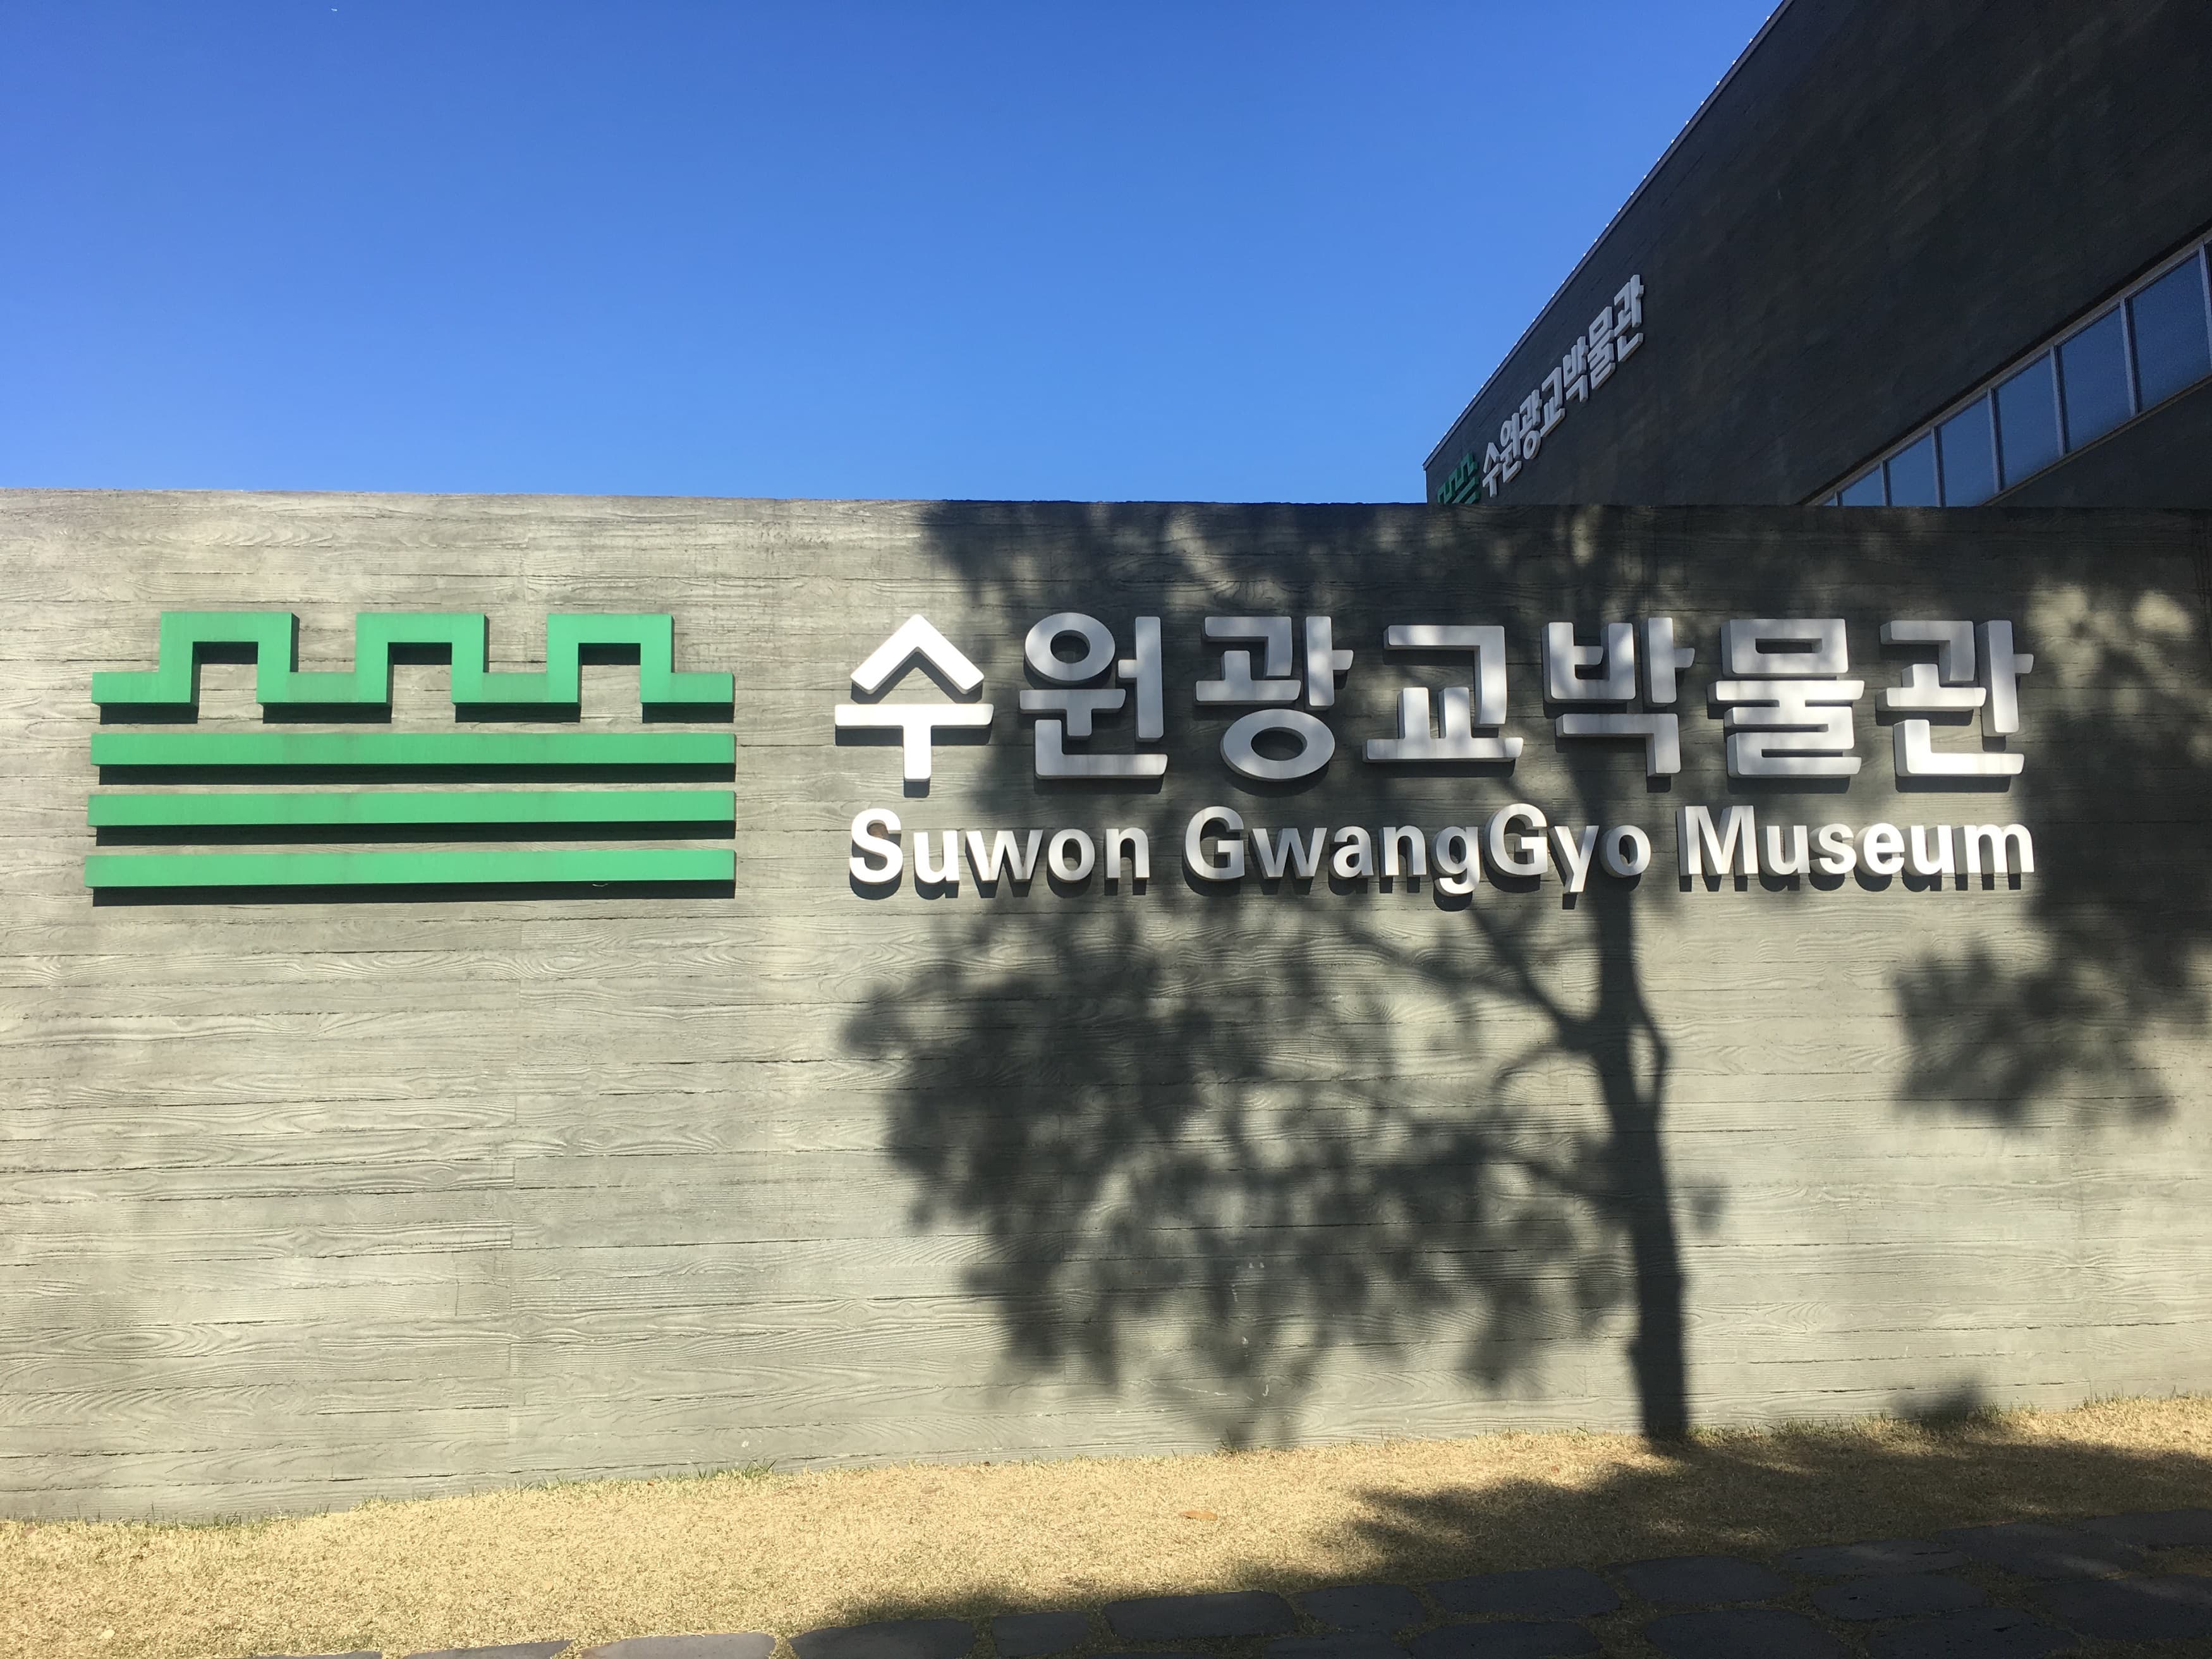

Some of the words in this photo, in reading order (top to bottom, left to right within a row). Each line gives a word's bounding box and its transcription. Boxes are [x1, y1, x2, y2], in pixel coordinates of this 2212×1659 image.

[1481, 274, 1644, 498] 수원광교박물관
[834, 612, 2034, 783] 수원광교박물관
[848, 807, 1151, 884] Suwon
[1183, 803, 1651, 896] GwangGyo
[1675, 805, 2034, 878] Museum
